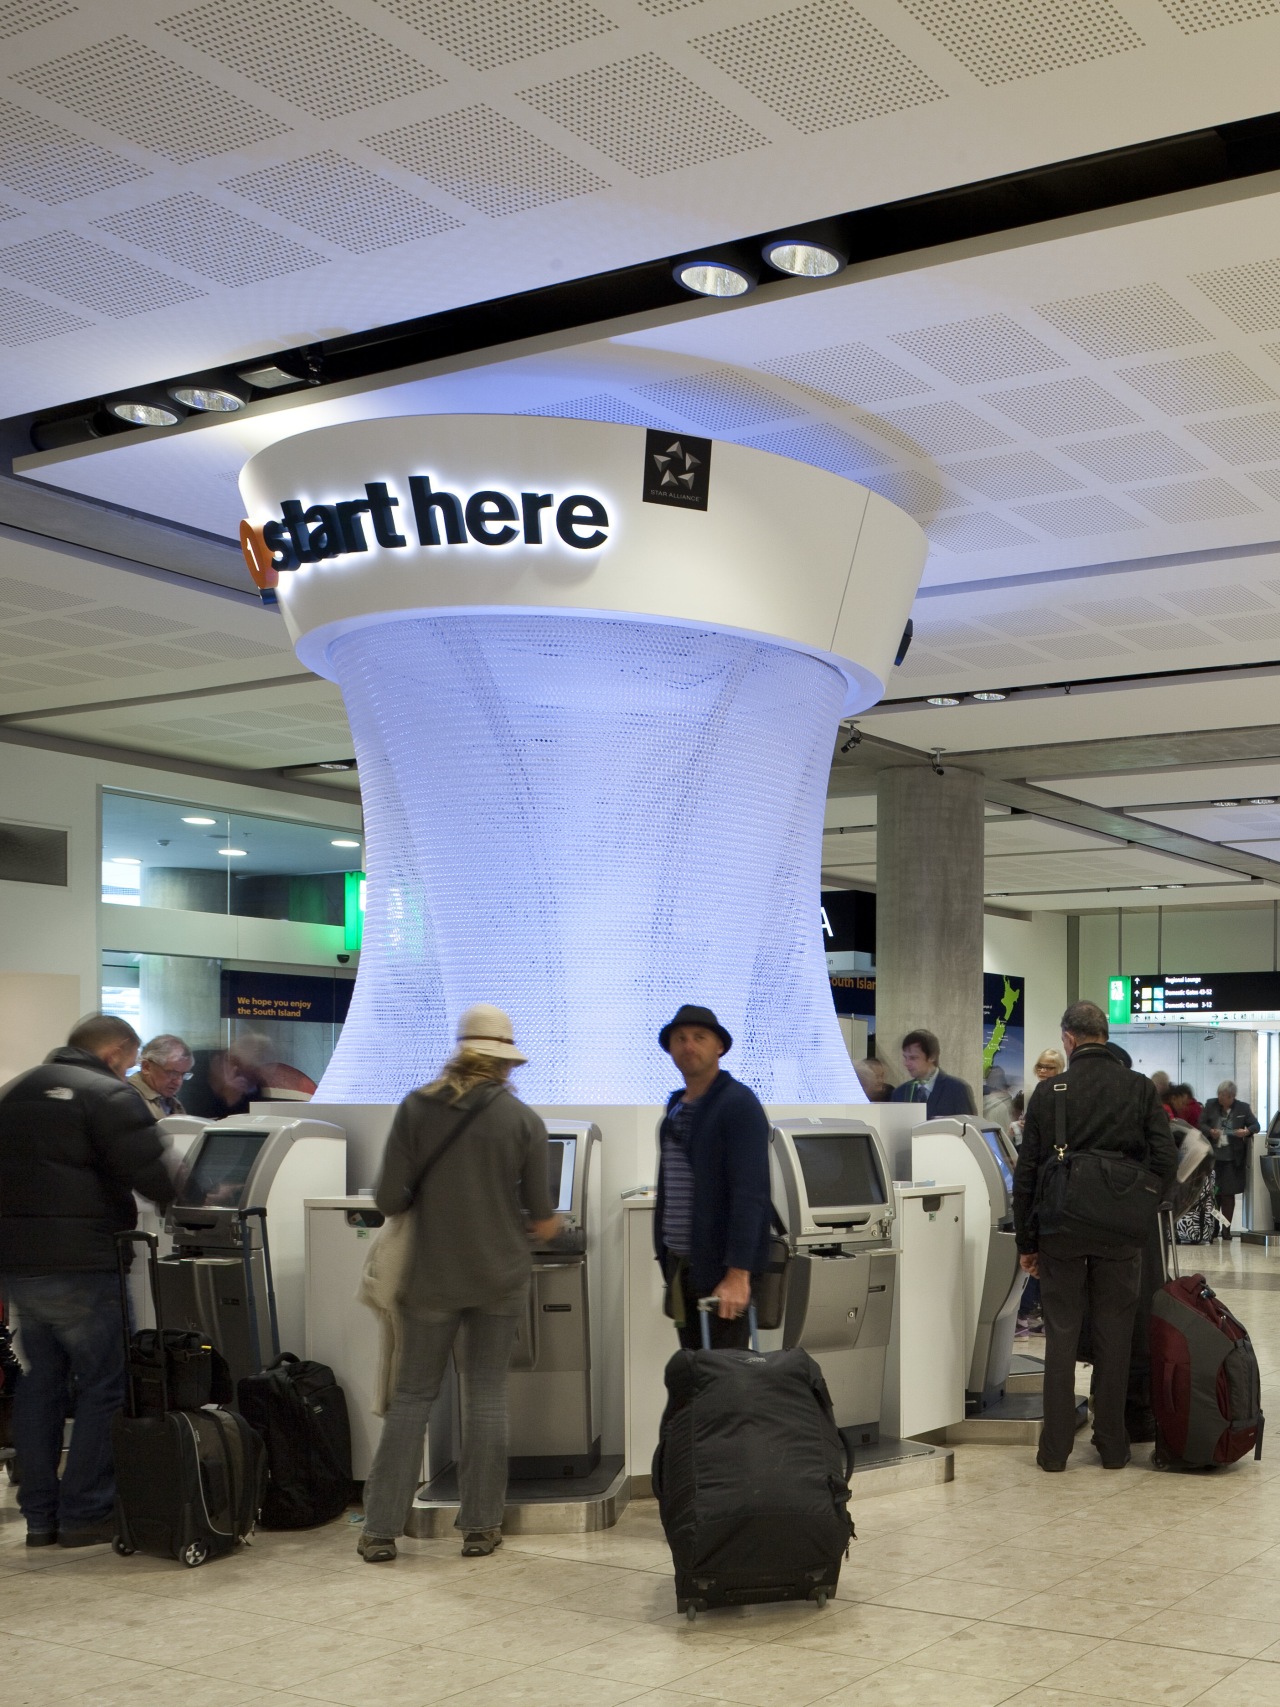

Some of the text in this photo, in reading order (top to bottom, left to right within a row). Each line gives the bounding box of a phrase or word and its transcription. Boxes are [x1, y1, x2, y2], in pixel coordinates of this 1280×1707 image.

[650, 489, 701, 502] STAR ALLIANCE
[263, 482, 407, 571] start
[408, 476, 609, 549] here
[830, 977, 854, 989] outh
[1165, 976, 1201, 984] Regional Lounge
[252, 998, 272, 1006] hope
[274, 999, 289, 1007] you
[290, 1001, 311, 1009] enjoy
[237, 1007, 301, 1017] the South Island
